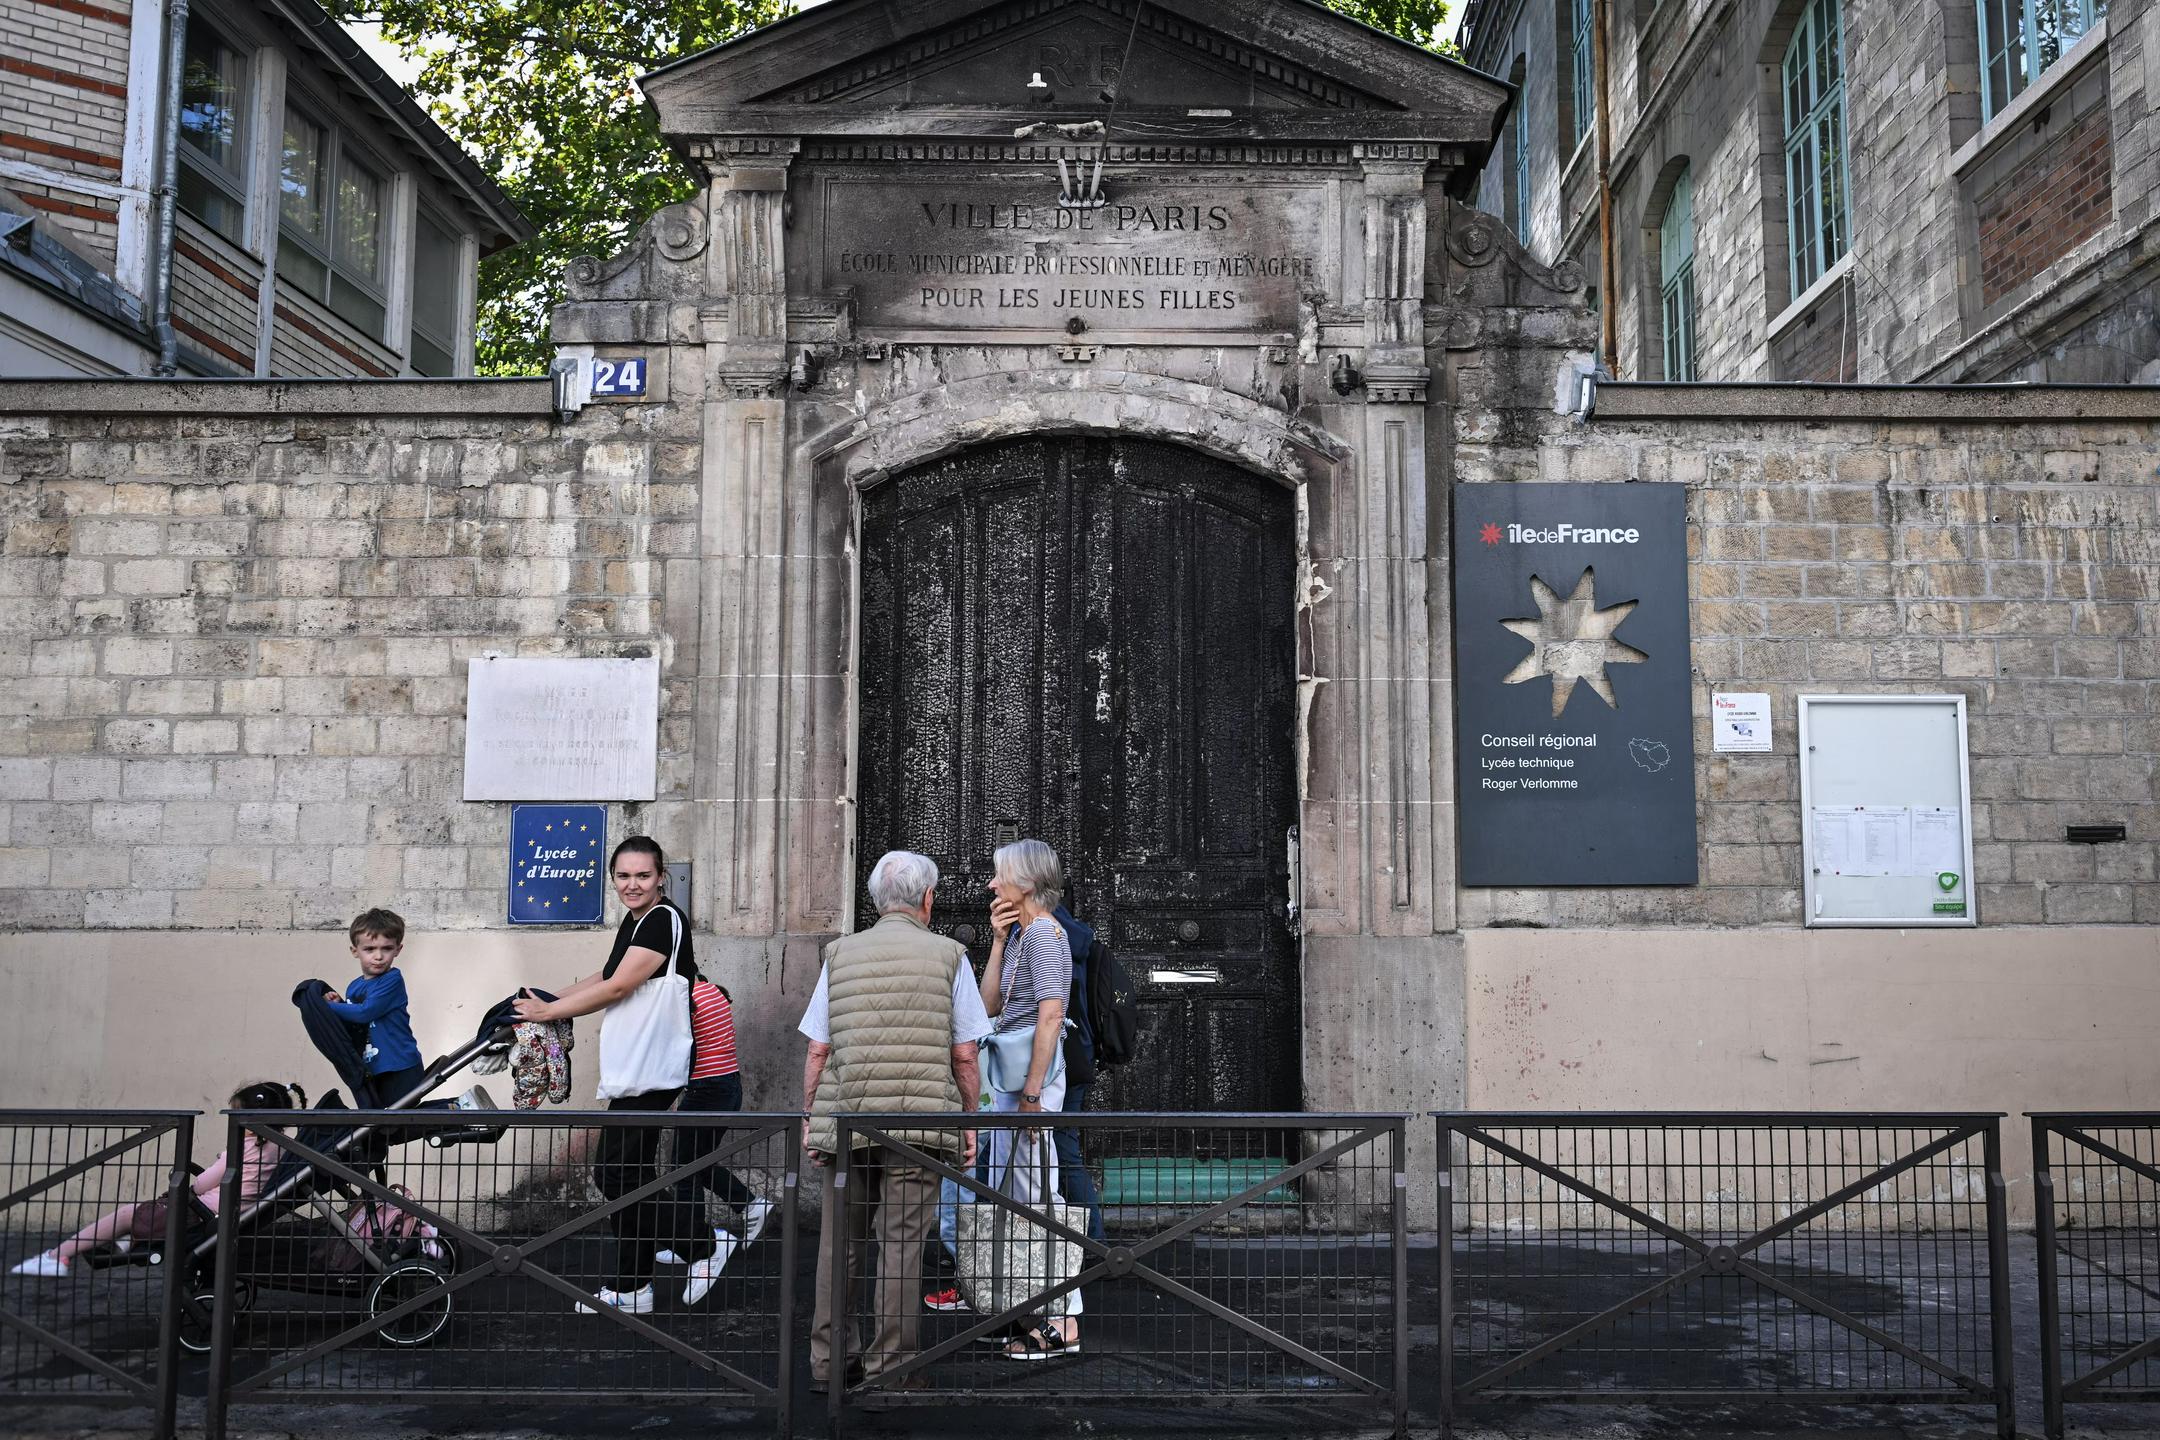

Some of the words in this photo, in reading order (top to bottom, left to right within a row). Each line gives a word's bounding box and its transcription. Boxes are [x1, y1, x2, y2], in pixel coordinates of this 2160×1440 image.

[921, 203, 1032, 229] VILLE
[1055, 207, 1094, 230] DE
[1116, 206, 1228, 231] PARIS
[841, 250, 897, 273] ÉCOLE
[907, 254, 1015, 275] MUNICIPALE
[1024, 255, 1185, 276] PROFESSIONNELLE
[921, 288, 984, 308] POUR
[999, 288, 1039, 308] LES
[1053, 289, 1144, 309] JEUNES
[1160, 290, 1235, 309] FILLES
[596, 361, 640, 391] 24
[1481, 734, 1534, 747] Conseil
[1539, 734, 1597, 750] régional
[1481, 757, 1515, 770] Lycée
[1519, 757, 1574, 770] technique
[1482, 778, 1517, 791] Roger
[1520, 778, 1578, 789] Verlomme
[534, 846, 577, 861] Lycée
[527, 865, 594, 880] d'Europe
